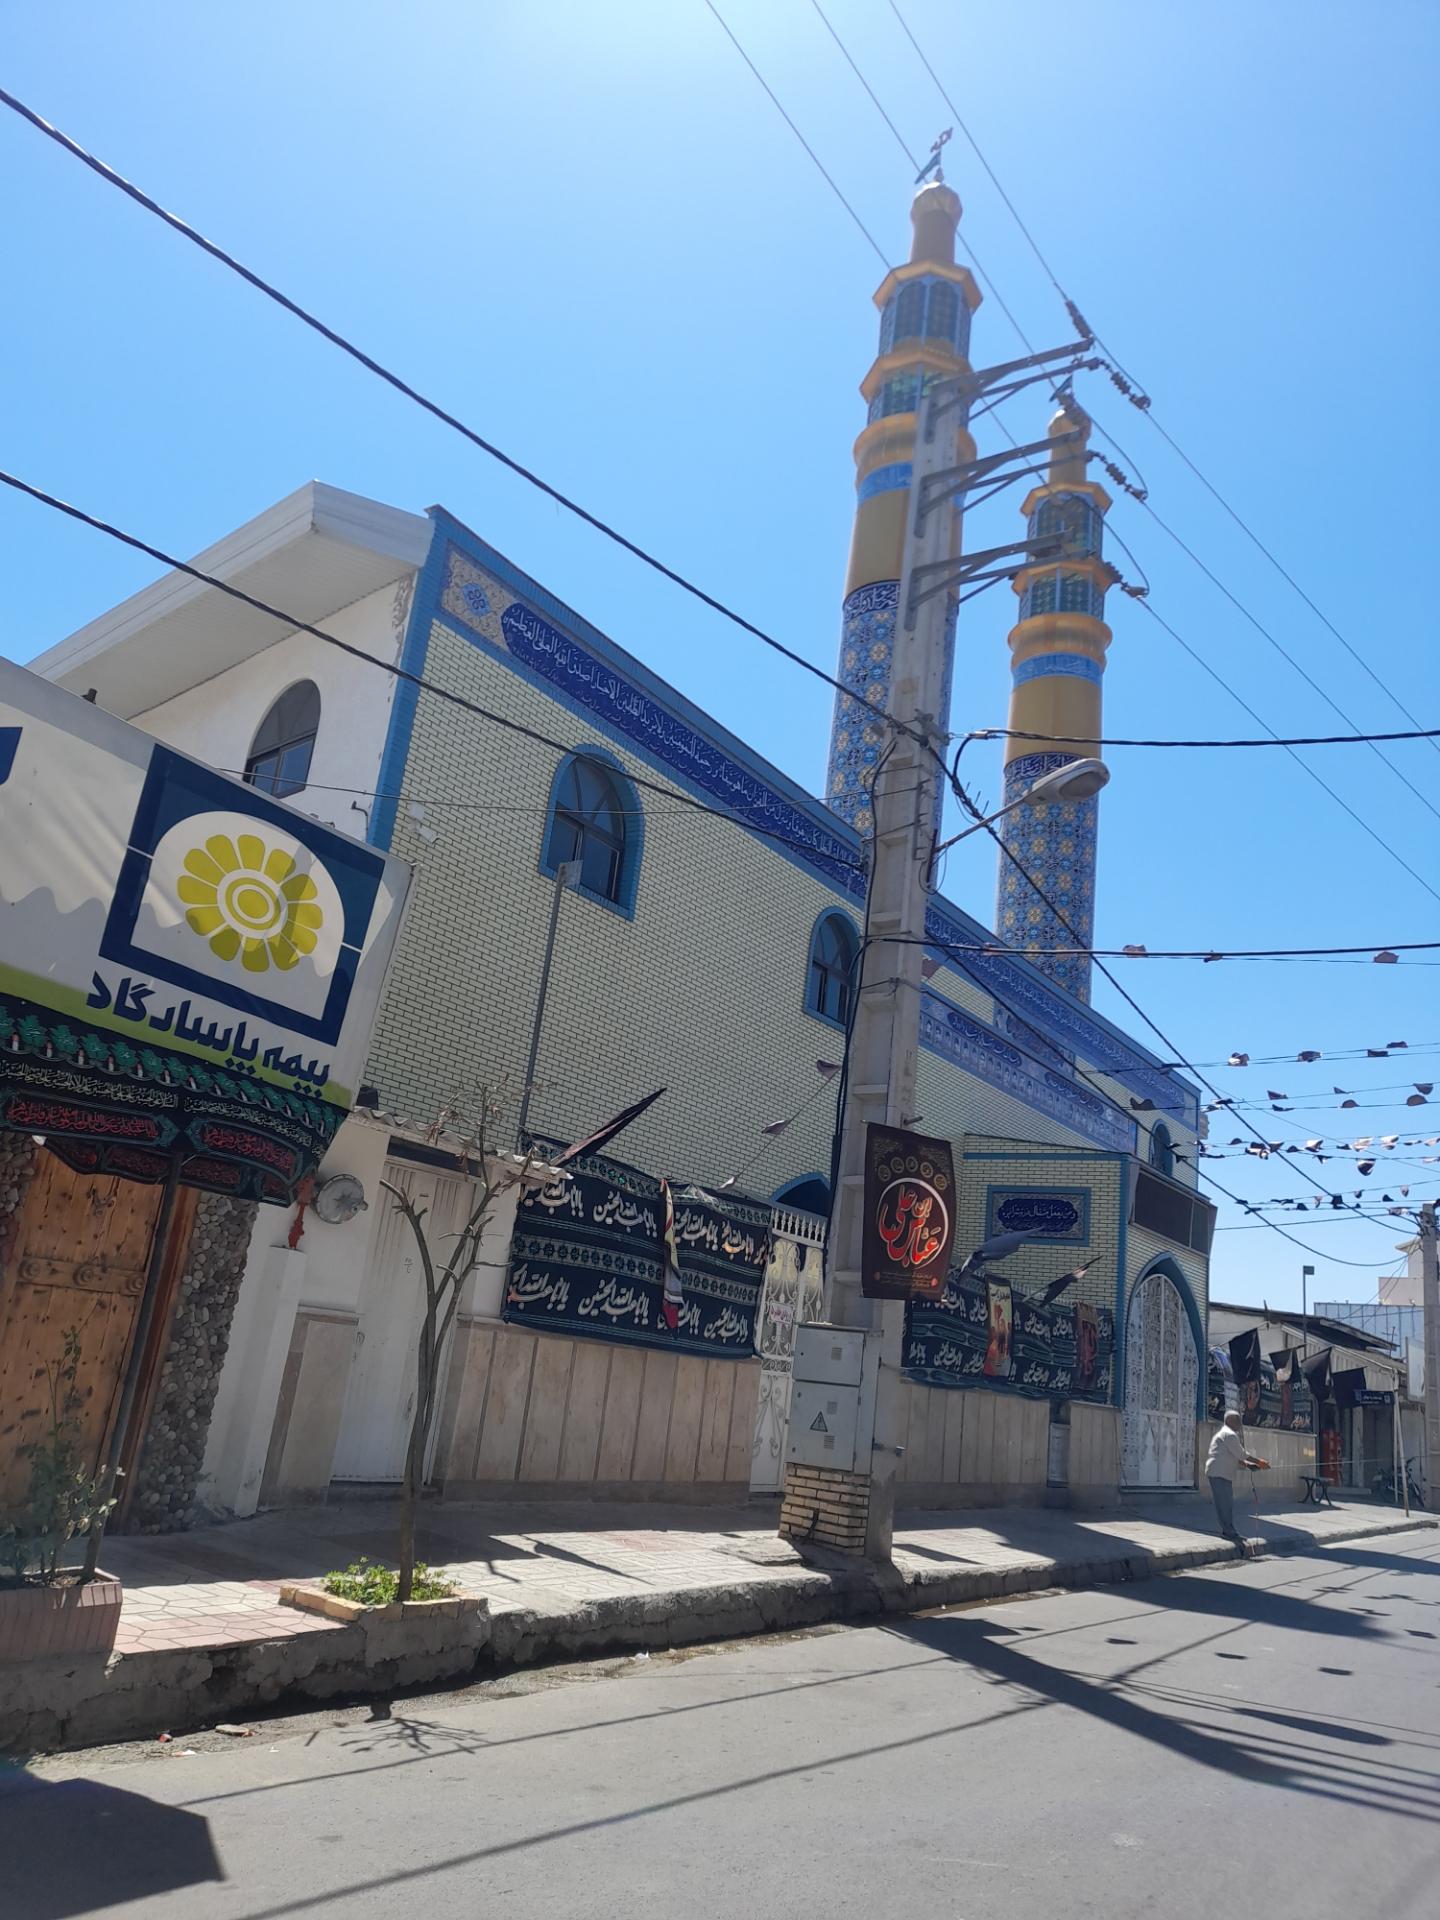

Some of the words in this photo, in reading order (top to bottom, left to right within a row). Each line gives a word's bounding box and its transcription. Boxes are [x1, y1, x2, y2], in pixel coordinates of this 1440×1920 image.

[86, 970, 259, 1075] پاسارگاد
[262, 1046, 330, 1098] بیمه
[887, 1217, 942, 1267] عباس
